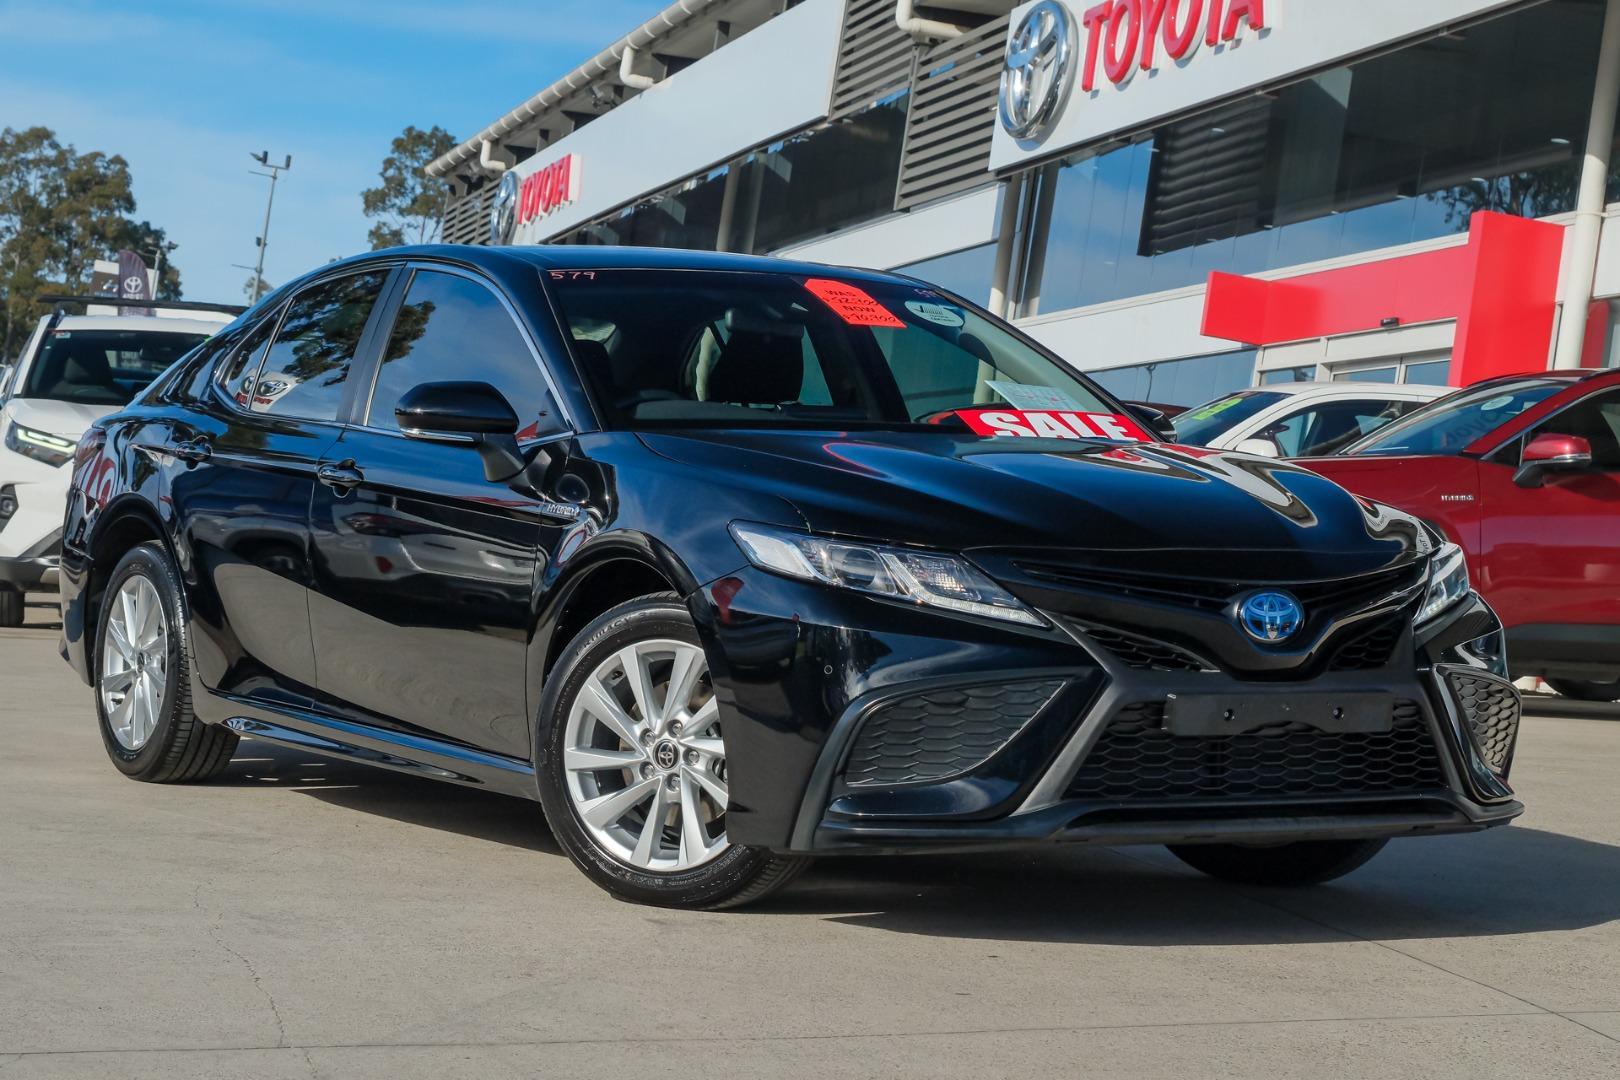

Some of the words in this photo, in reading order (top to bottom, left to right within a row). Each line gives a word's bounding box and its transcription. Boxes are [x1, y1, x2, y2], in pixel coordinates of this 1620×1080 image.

[515, 153, 572, 224] TOYOTA
[550, 271, 596, 280] 579
[843, 305, 875, 313] NOW
[979, 411, 1138, 442] SALE
